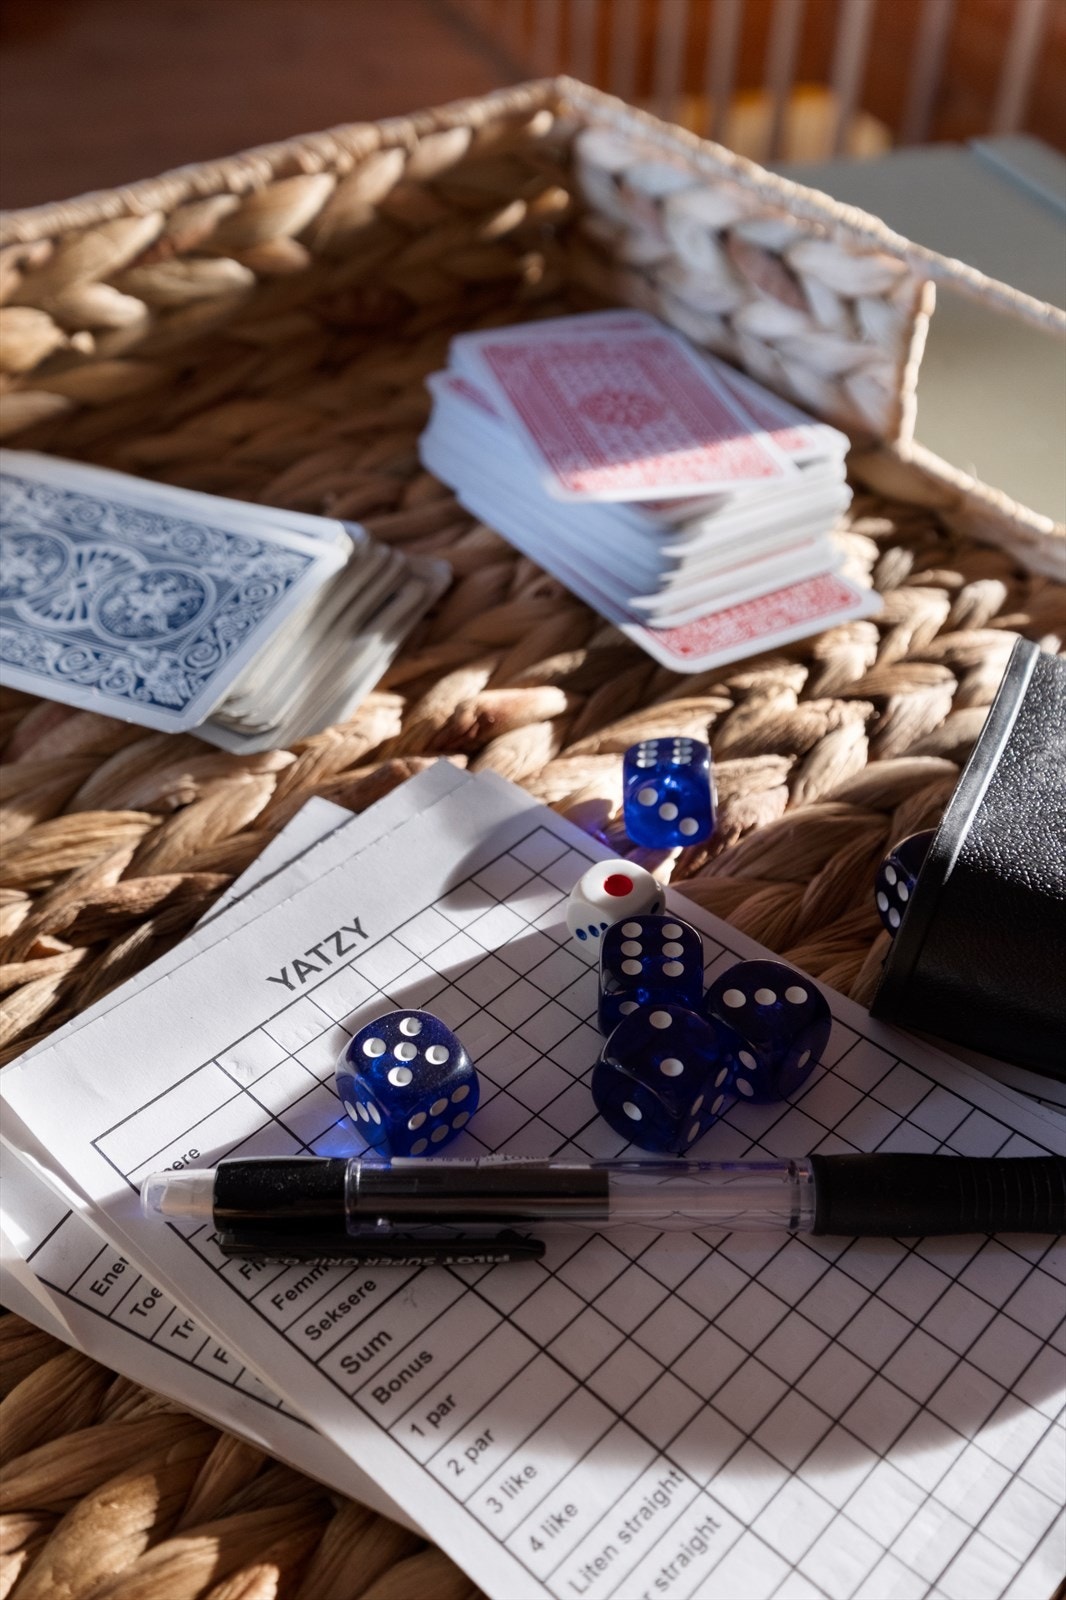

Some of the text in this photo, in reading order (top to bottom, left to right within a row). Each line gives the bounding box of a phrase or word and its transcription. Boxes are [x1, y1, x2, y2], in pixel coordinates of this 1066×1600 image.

[265, 916, 369, 991] YATZY
[162, 1148, 200, 1172] ere
[364, 1257, 436, 1266] SUPER
[443, 1254, 510, 1265] PILOT
[129, 1287, 163, 1317] Toe
[304, 1279, 377, 1341] Seksere
[340, 1329, 393, 1375] Sum
[371, 1350, 434, 1405] Bonus
[409, 1394, 457, 1437] 1 par
[447, 1428, 495, 1476] 2 par
[486, 1465, 538, 1514] 3 like
[529, 1503, 579, 1553] 4 like
[568, 1469, 684, 1595] Liten straight
[654, 1515, 722, 1592] straight
